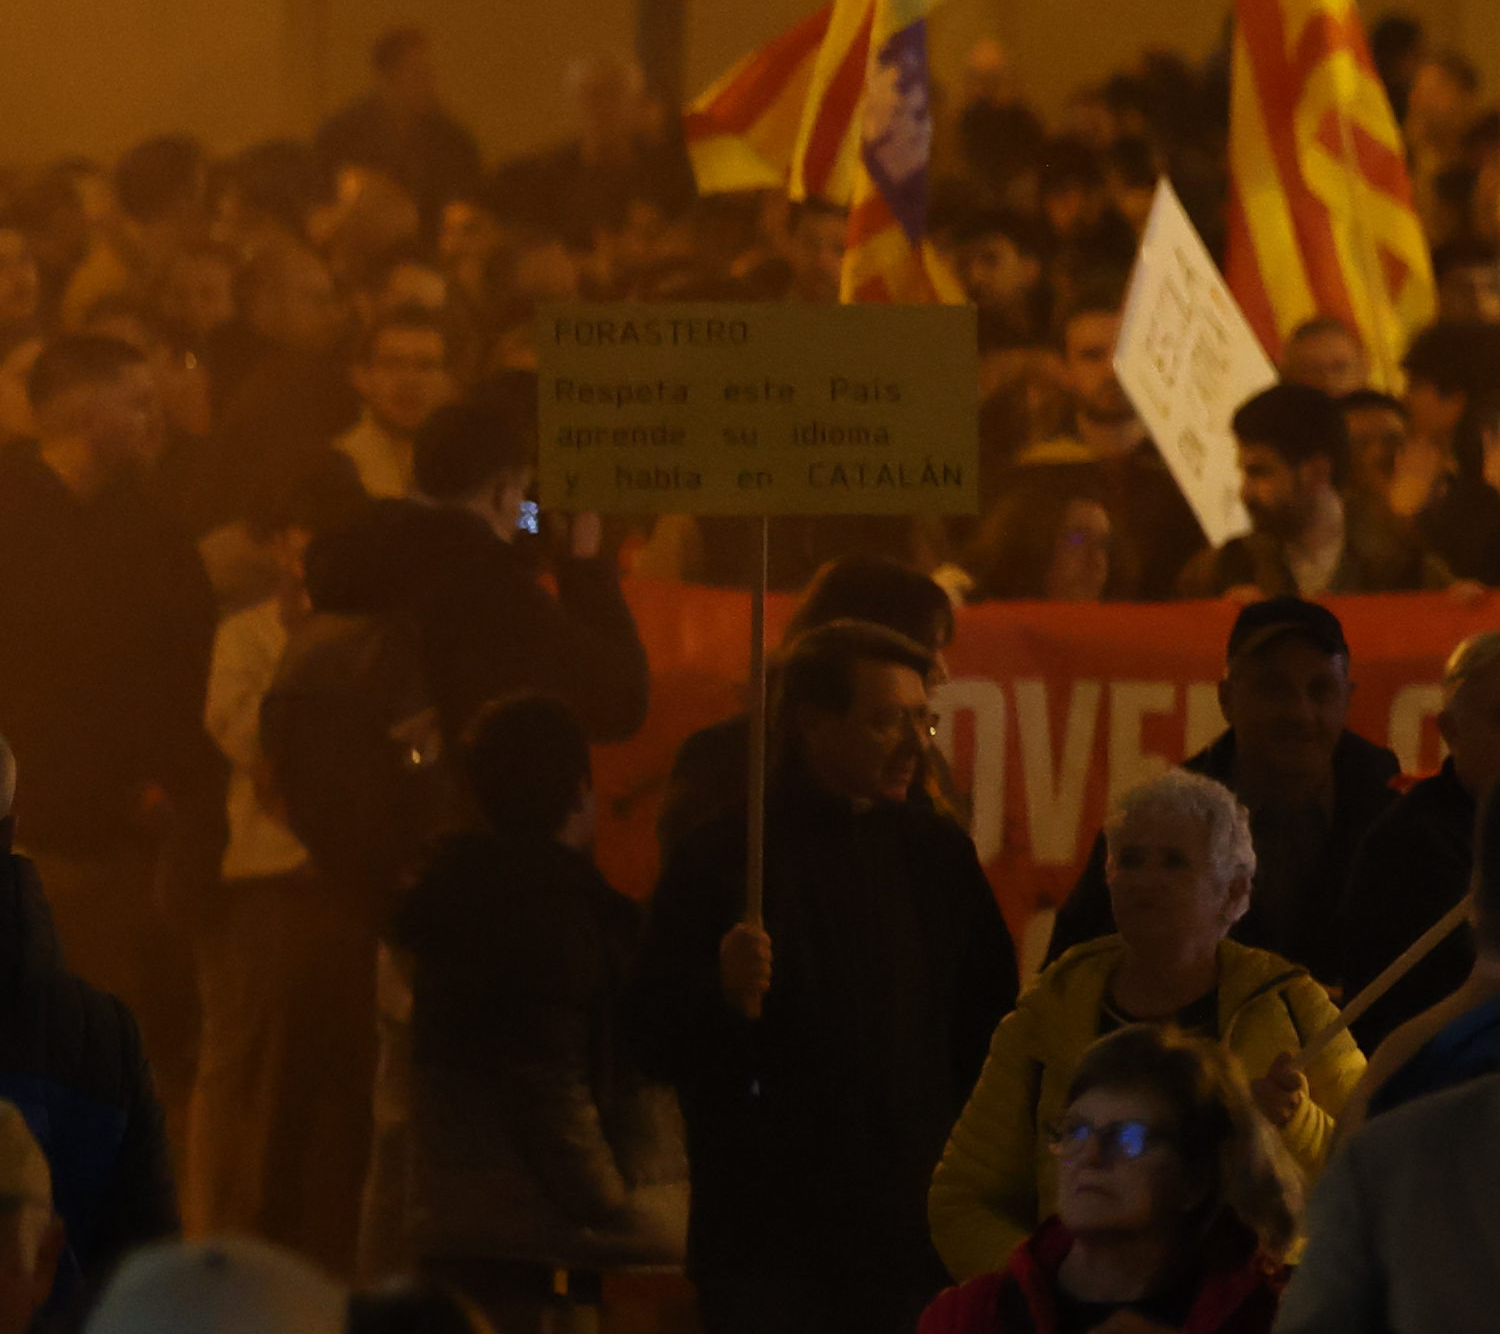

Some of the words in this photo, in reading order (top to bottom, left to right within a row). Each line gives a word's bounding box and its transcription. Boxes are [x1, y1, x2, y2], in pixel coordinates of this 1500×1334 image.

[554, 318, 750, 346] FORASTERO
[553, 376, 690, 408] Respeta
[723, 378, 797, 404] este
[557, 422, 688, 454] aprende
[721, 428, 759, 448] su
[792, 421, 892, 448] idioma
[564, 470, 580, 496] y
[615, 464, 705, 491] habla
[737, 468, 773, 490] en
